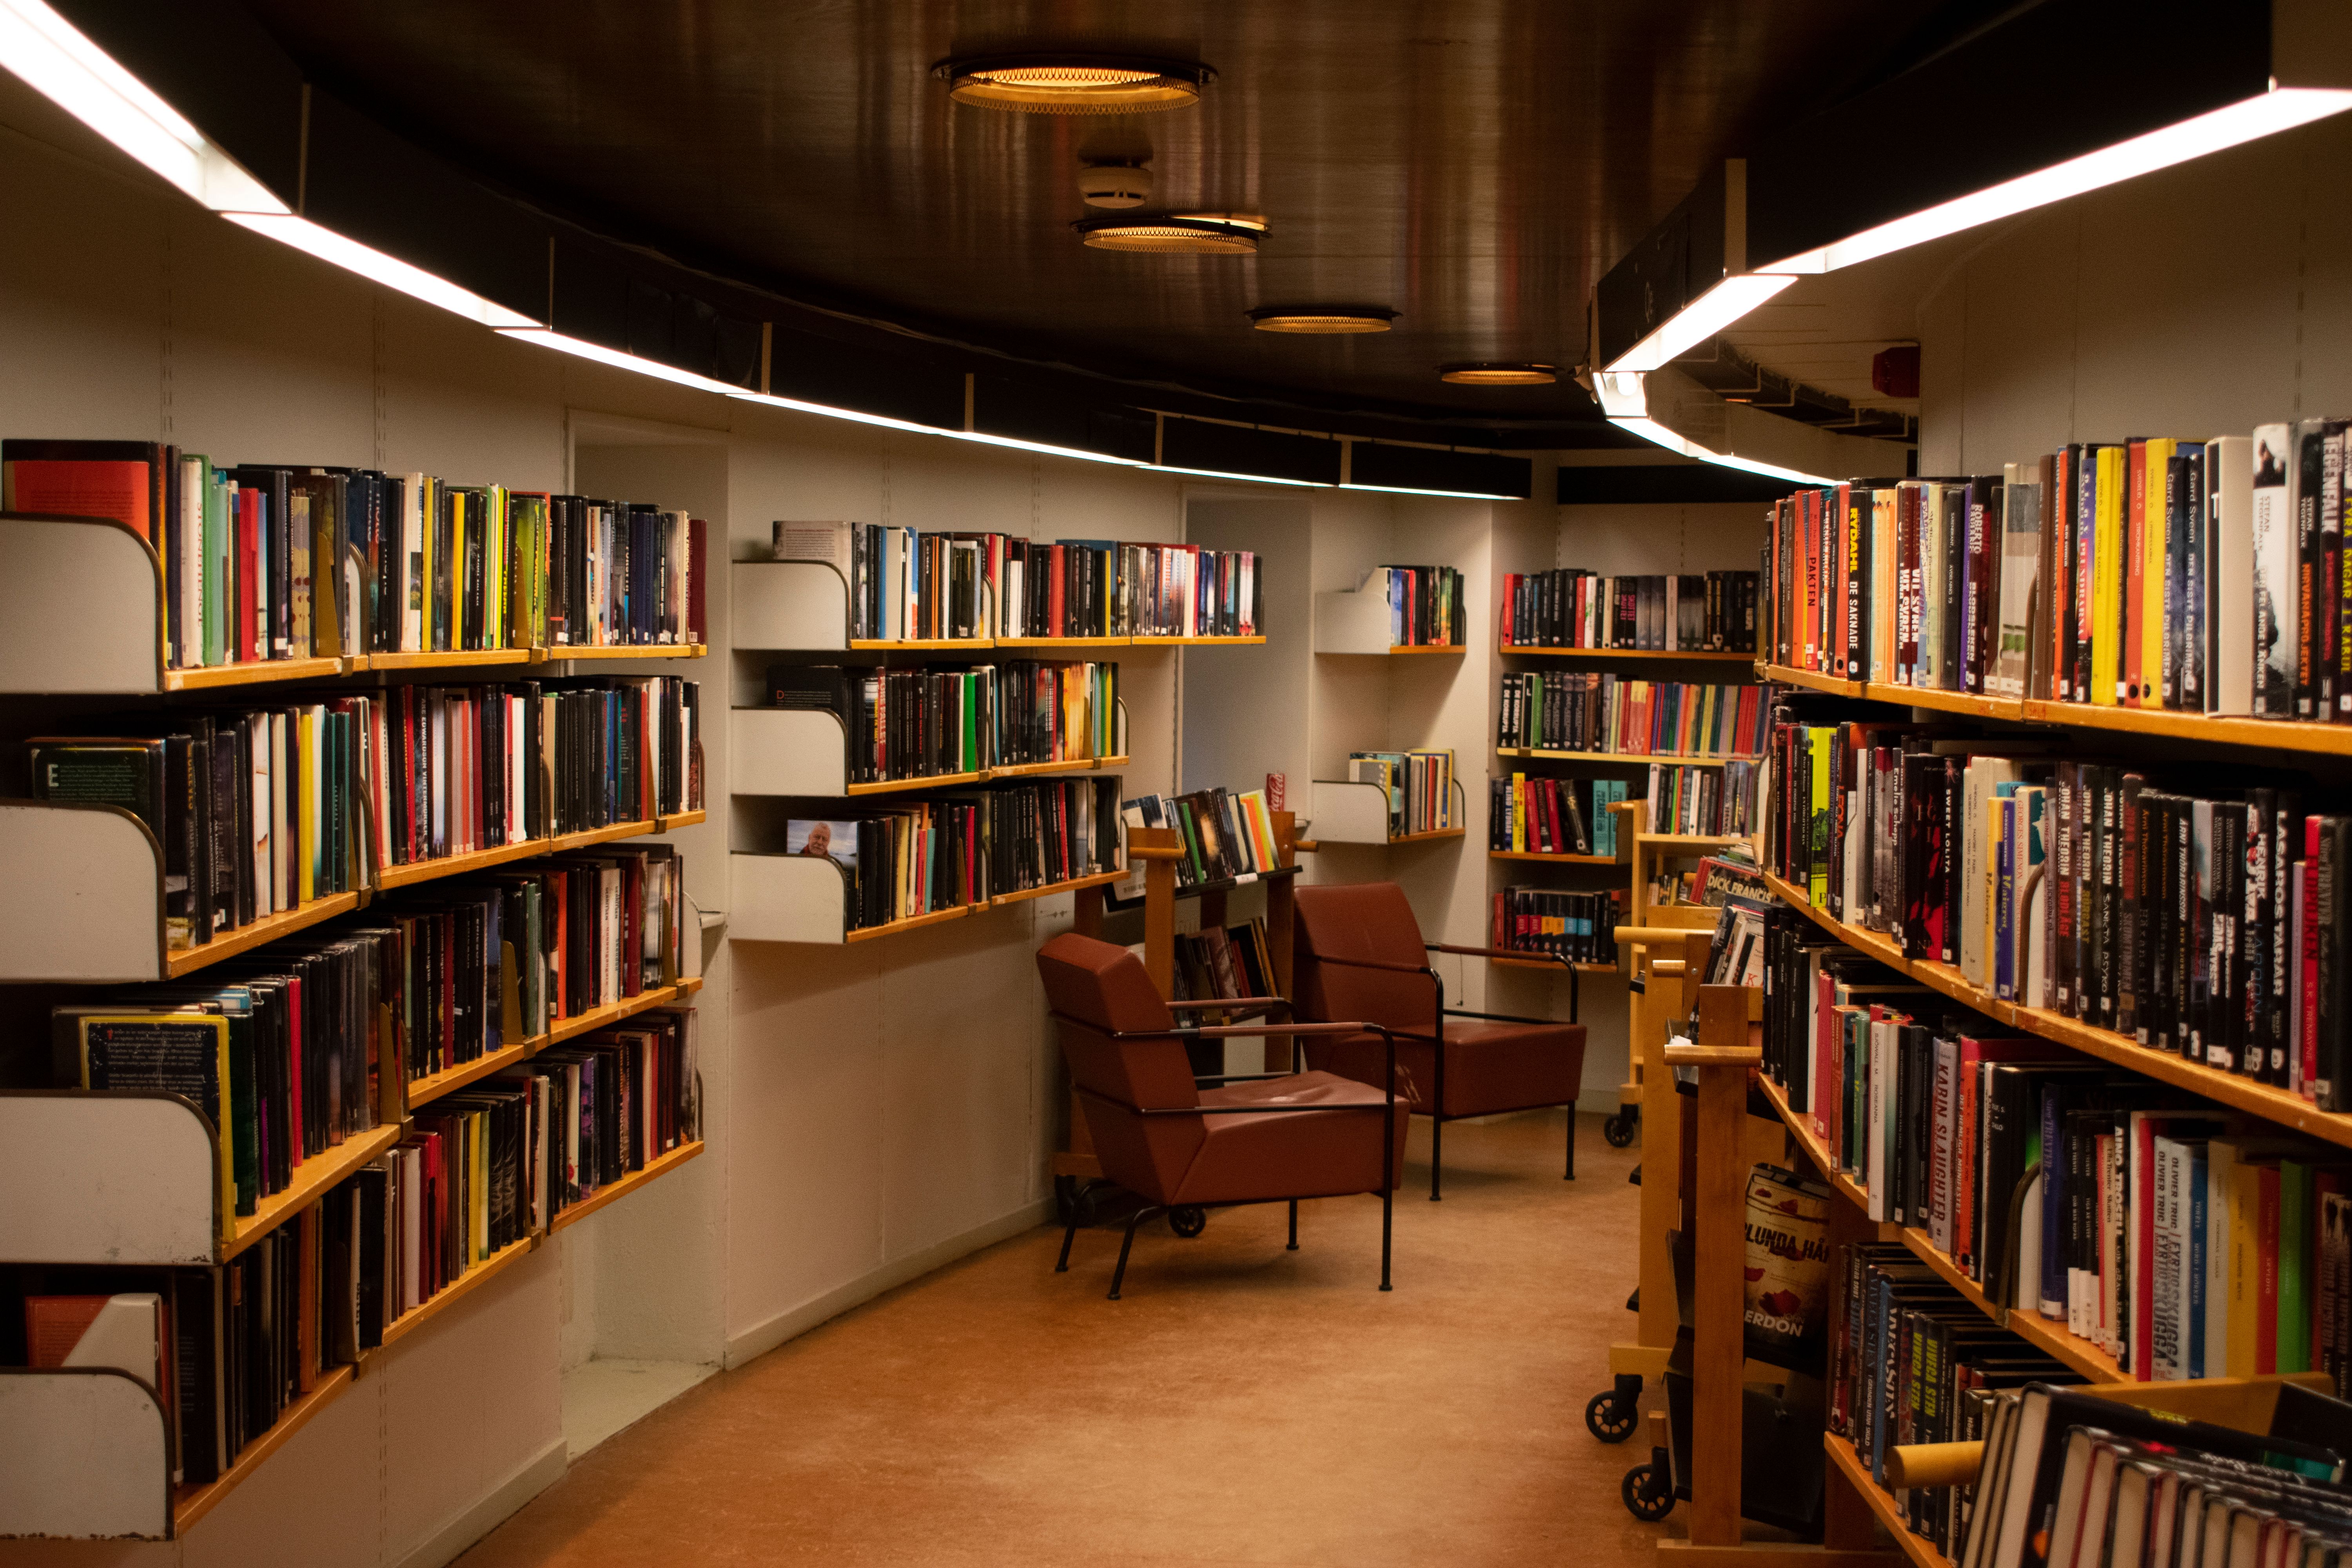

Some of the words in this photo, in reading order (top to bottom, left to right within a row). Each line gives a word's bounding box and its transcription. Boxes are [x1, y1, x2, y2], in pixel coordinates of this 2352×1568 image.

[2189, 472, 2198, 503] Gard
[2321, 433, 2343, 534] TEGENFALK
[1849, 508, 1858, 573] RYDAHL
[1975, 504, 1984, 554] ROBERTO
[2189, 506, 2197, 543] Sveen
[1808, 557, 1817, 607] PAKTEN
[1849, 581, 1857, 595] DE
[2078, 542, 2086, 635] PLUNDRARNA
[2164, 553, 2172, 577] DEN
[2342, 549, 2352, 599] DAGAR
[1911, 595, 1920, 642] SYREN
[2163, 580, 2172, 612] SISTE
[1849, 599, 1857, 649] SAKNADE
[2162, 615, 2171, 677] PILGRIMEN
[2185, 615, 2194, 680] PILGRIMEN
[2299, 563, 2312, 686] NIRVANAPROJEKTET
[2256, 642, 2268, 690] LÄNKEN
[2340, 624, 2351, 674] KABUL
[2060, 781, 2071, 820] JOHAN
[2082, 784, 2091, 824] JOHAN
[2103, 787, 2114, 827] JOHAN
[1892, 808, 1900, 846] Schepp
[2060, 826, 2070, 876] THEORIN
[2082, 831, 2091, 881] THEORIN
[2102, 833, 2113, 885] THEORIN
[2255, 833, 2269, 900] HENRIK
[2274, 811, 2288, 919] LASAROS
[1706, 875, 1730, 892] DICK
[1731, 880, 1772, 903] FRANCIS
[2002, 874, 2011, 929] Maigret
[2103, 893, 2111, 944] SANKTA
[2102, 951, 2110, 993] PSYKO
[2138, 978, 2147, 1005] tid
[1937, 1064, 1949, 1118] KARIN
[2114, 1126, 2124, 1167] AINO
[1934, 1124, 1947, 1221] SLAUGHTER
[2171, 1157, 2179, 1198] OLIVIER
[2114, 1172, 2123, 1235] TROSELL
[1744, 1306, 1804, 1335] ERDON
[1868, 1278, 1878, 1327] VIVECA
[2153, 1280, 2167, 1359] SKUGGA
[1867, 1331, 1876, 1368] STEN
[2167, 1290, 2180, 1368] SKUGGA
[1913, 1332, 1923, 1377] VIVECA
[1926, 1338, 1938, 1383] VIVECA
[1911, 1379, 1921, 1411] STEN
[1925, 1386, 1936, 1417] STEN
